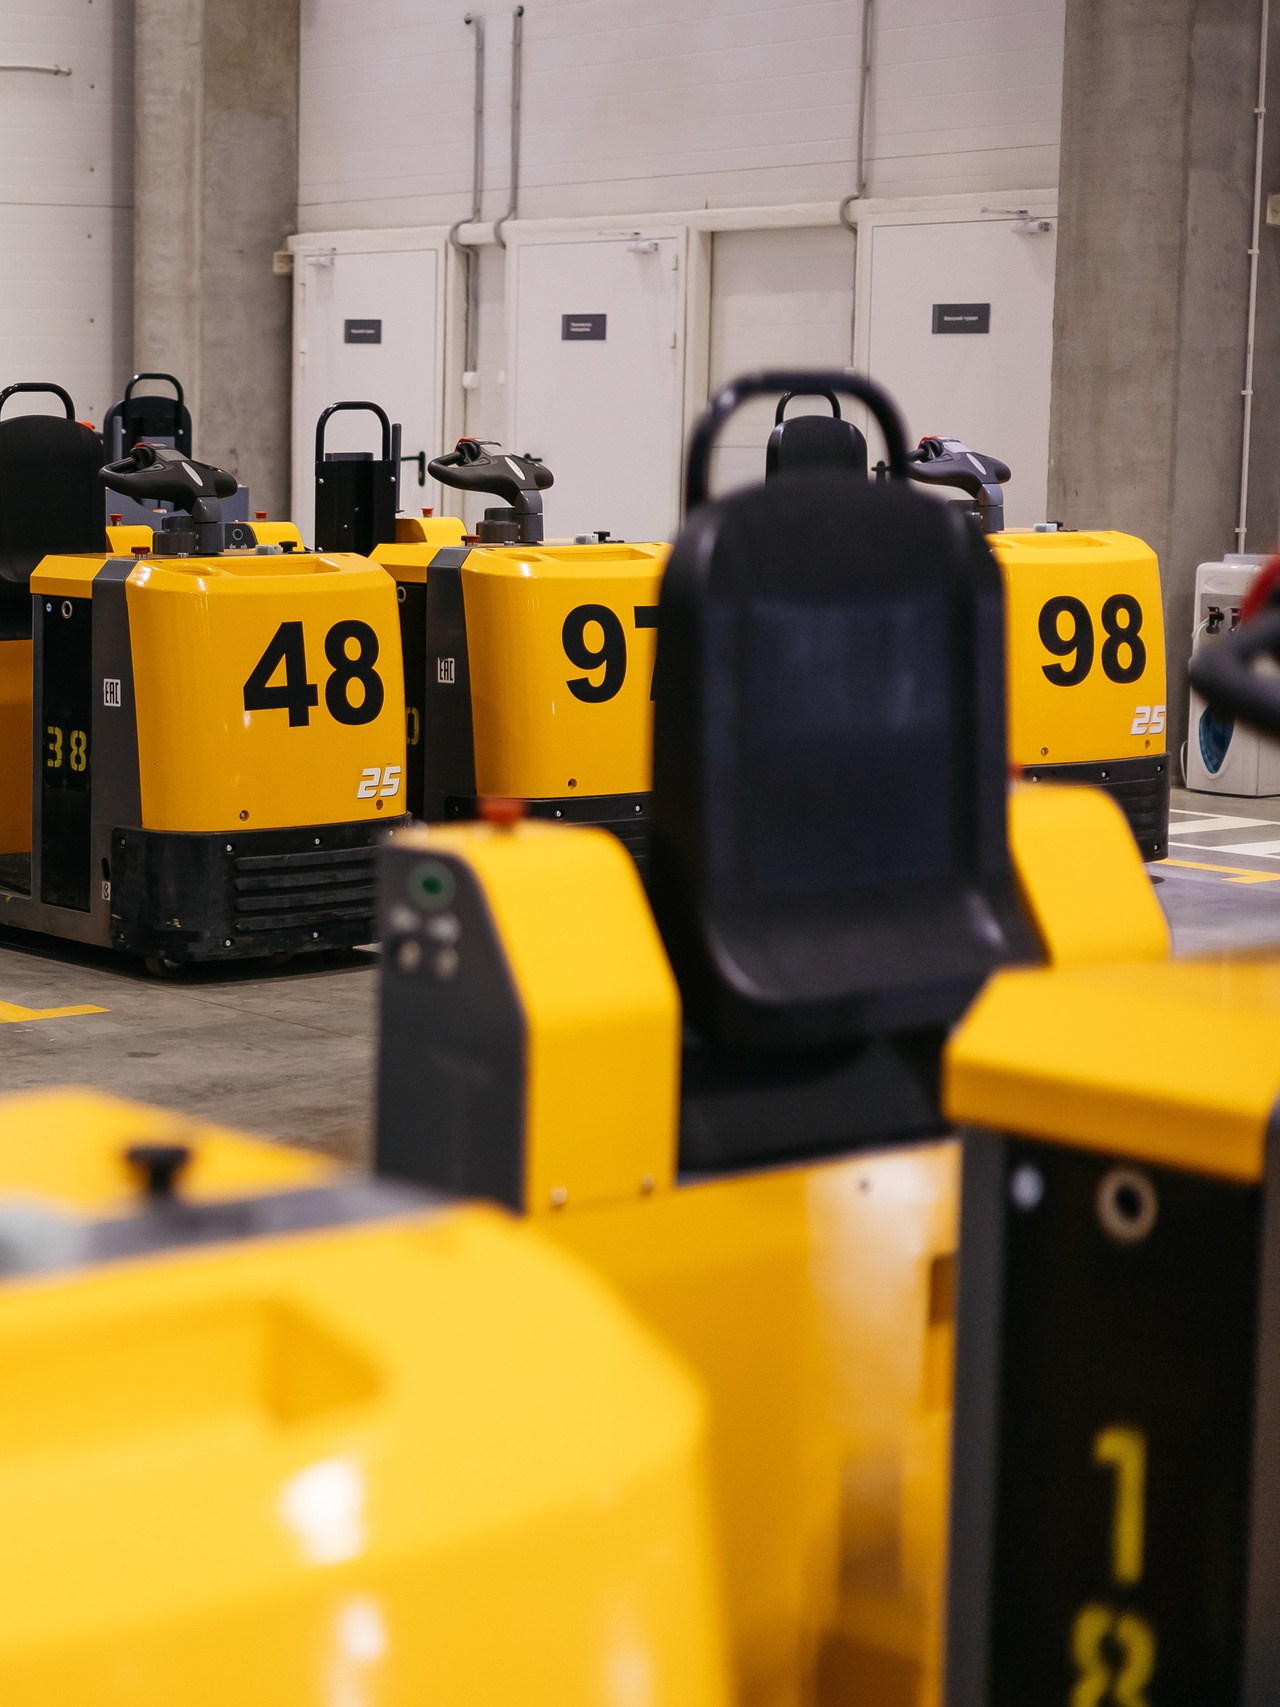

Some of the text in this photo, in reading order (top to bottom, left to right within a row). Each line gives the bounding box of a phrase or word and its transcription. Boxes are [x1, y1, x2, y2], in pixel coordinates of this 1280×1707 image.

[1038, 594, 1146, 687] 98
[105, 681, 120, 705] EAC
[243, 620, 384, 728] 48
[1130, 705, 1166, 736] 25
[47, 726, 87, 772] 38
[357, 765, 401, 799] 25
